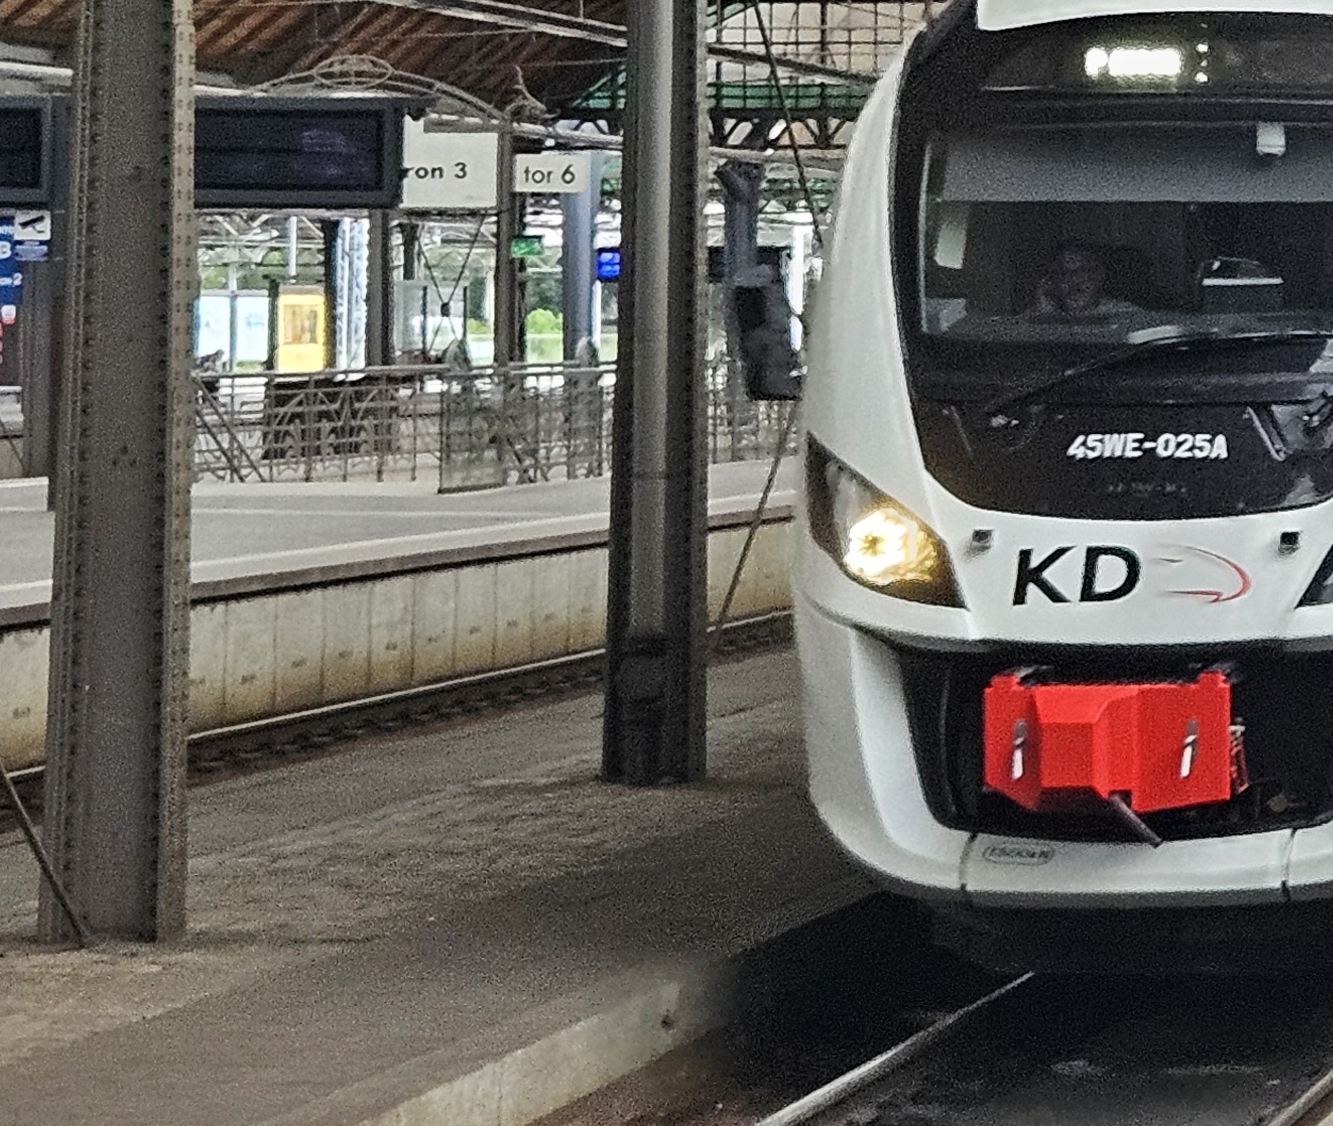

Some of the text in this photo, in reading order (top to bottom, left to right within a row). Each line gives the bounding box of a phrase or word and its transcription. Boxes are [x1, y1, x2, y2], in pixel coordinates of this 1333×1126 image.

[454, 162, 468, 180] 3
[523, 164, 576, 184] tor 6
[1067, 433, 1229, 459] 45WE-025A
[1012, 545, 1142, 606] KD
